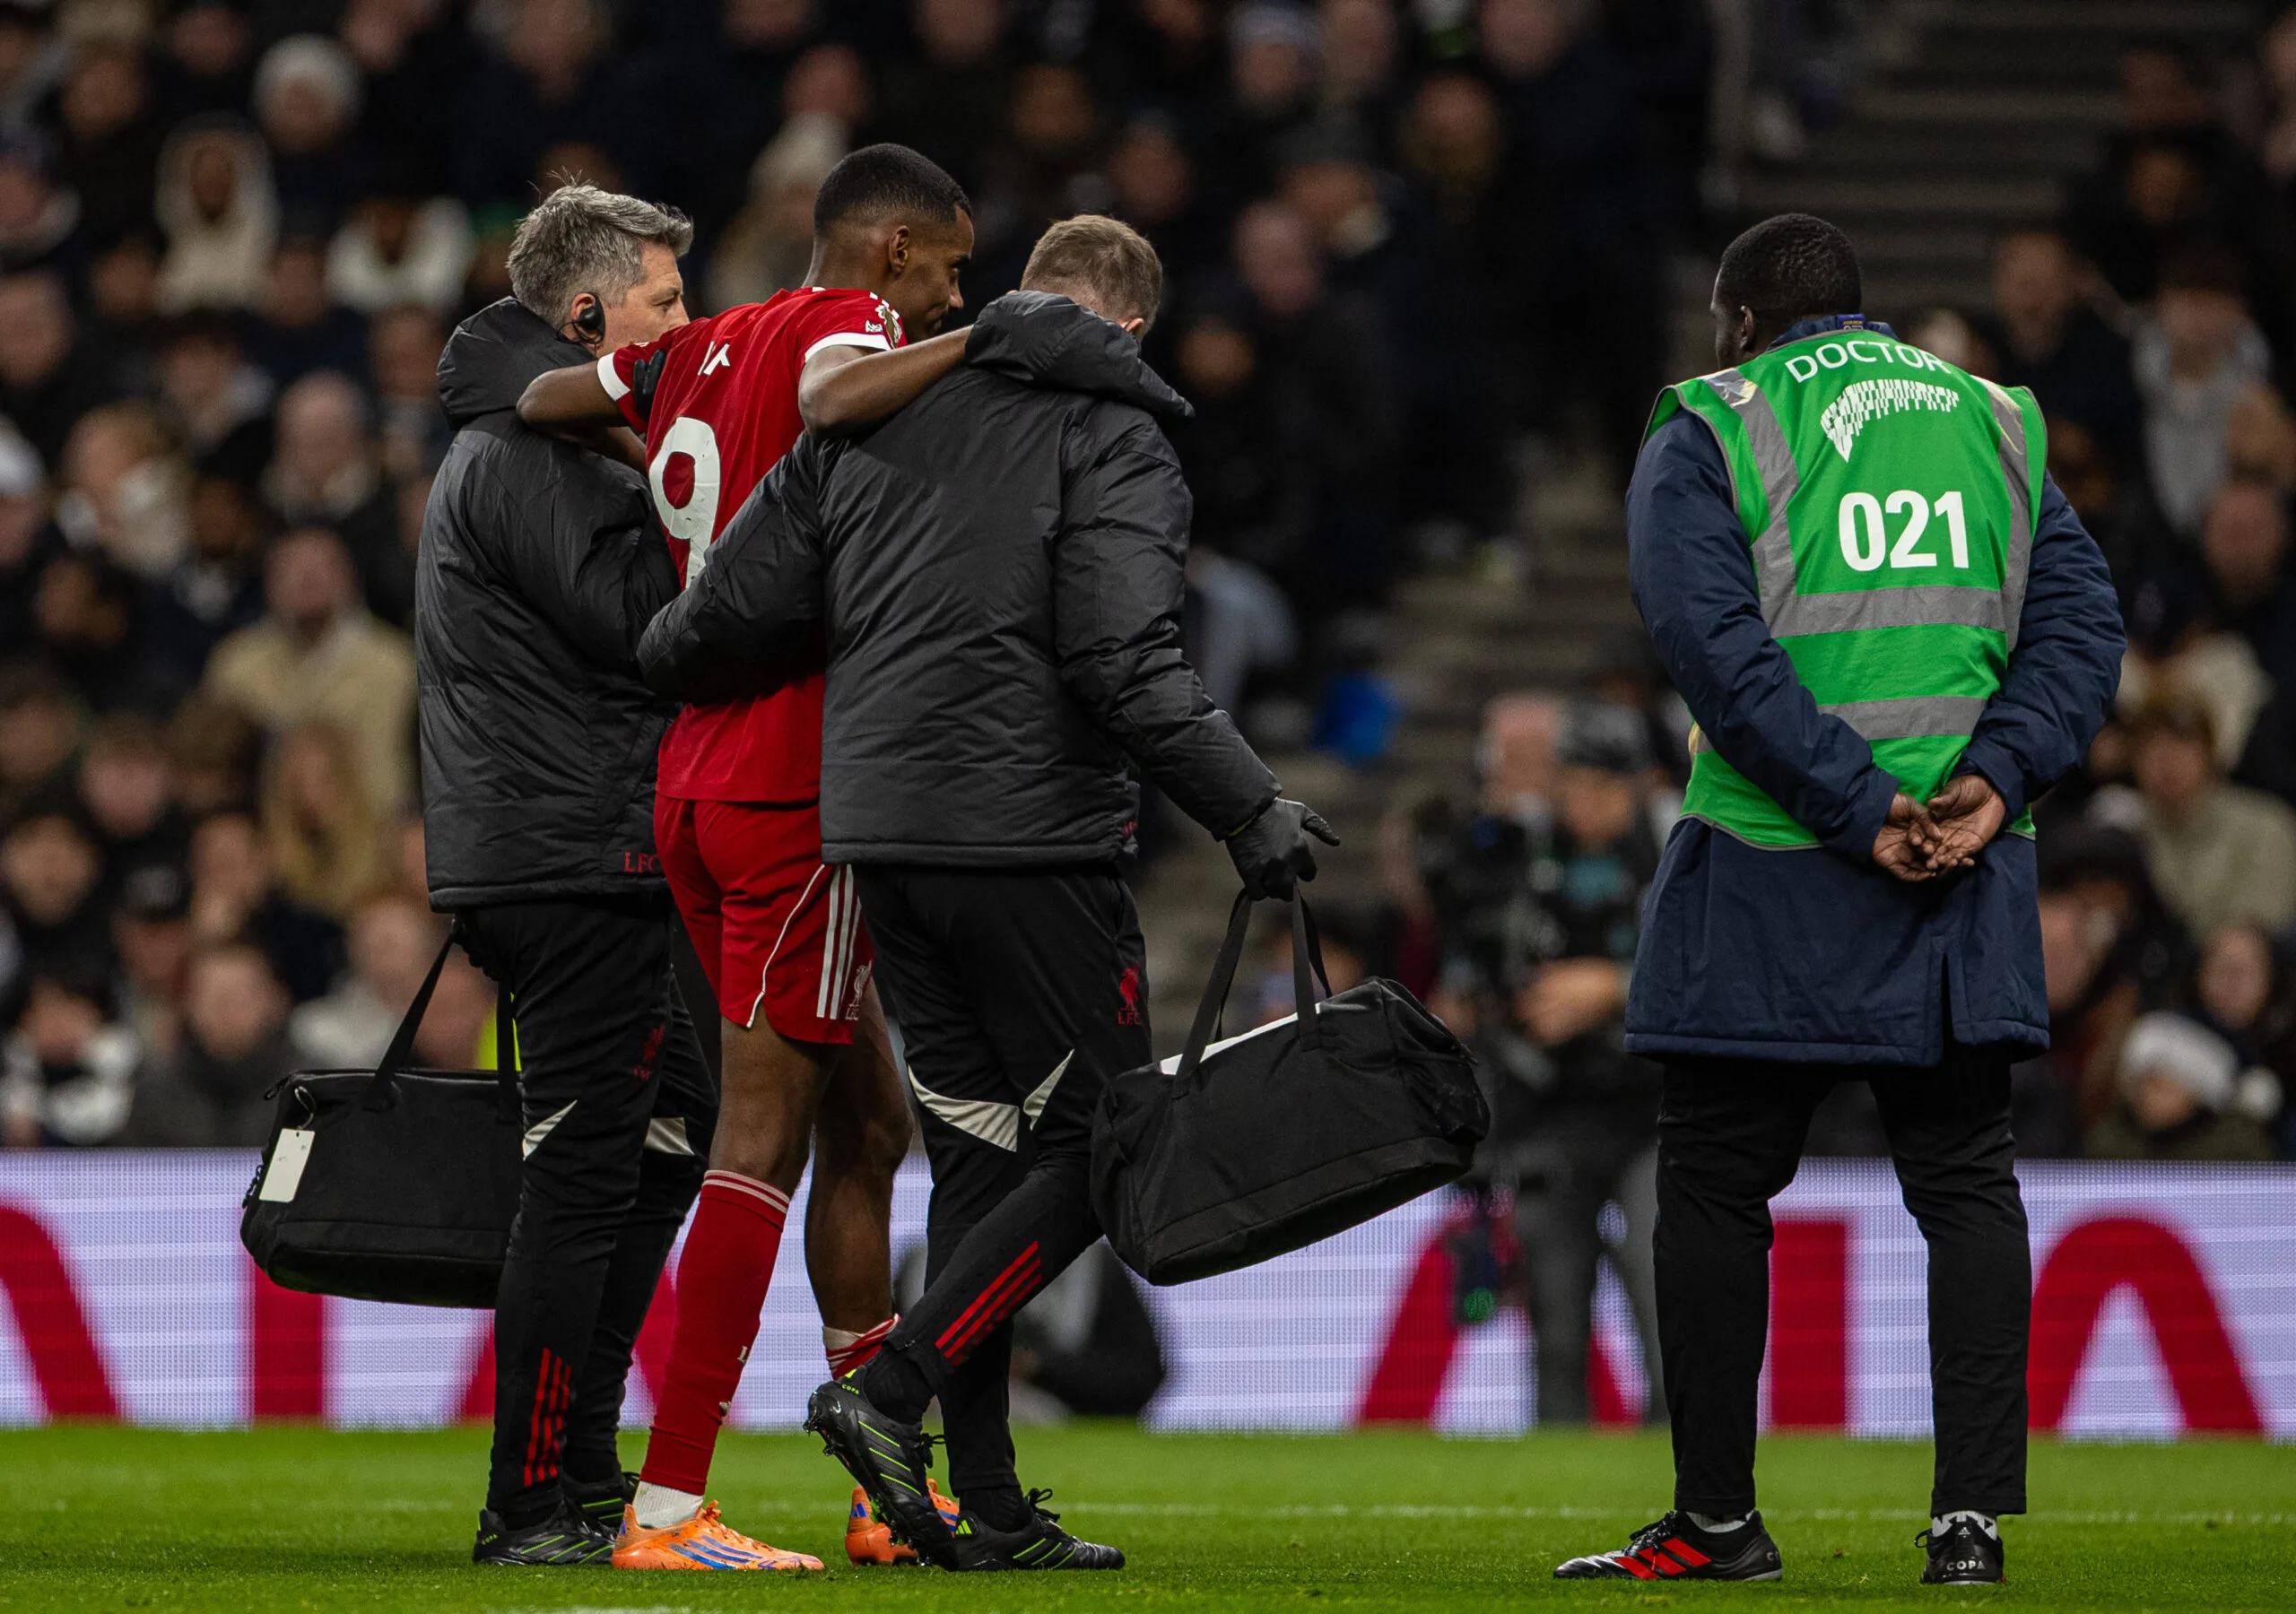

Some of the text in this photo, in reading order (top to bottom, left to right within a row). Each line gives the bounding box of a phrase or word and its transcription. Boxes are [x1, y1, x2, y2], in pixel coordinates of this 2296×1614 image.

[1785, 340, 1952, 383] DOCTOR
[648, 416, 720, 590] 9
[1838, 490, 1970, 571] 021
[1118, 1011, 1142, 1025] LFC
[1946, 1560, 1986, 1571] COPA
